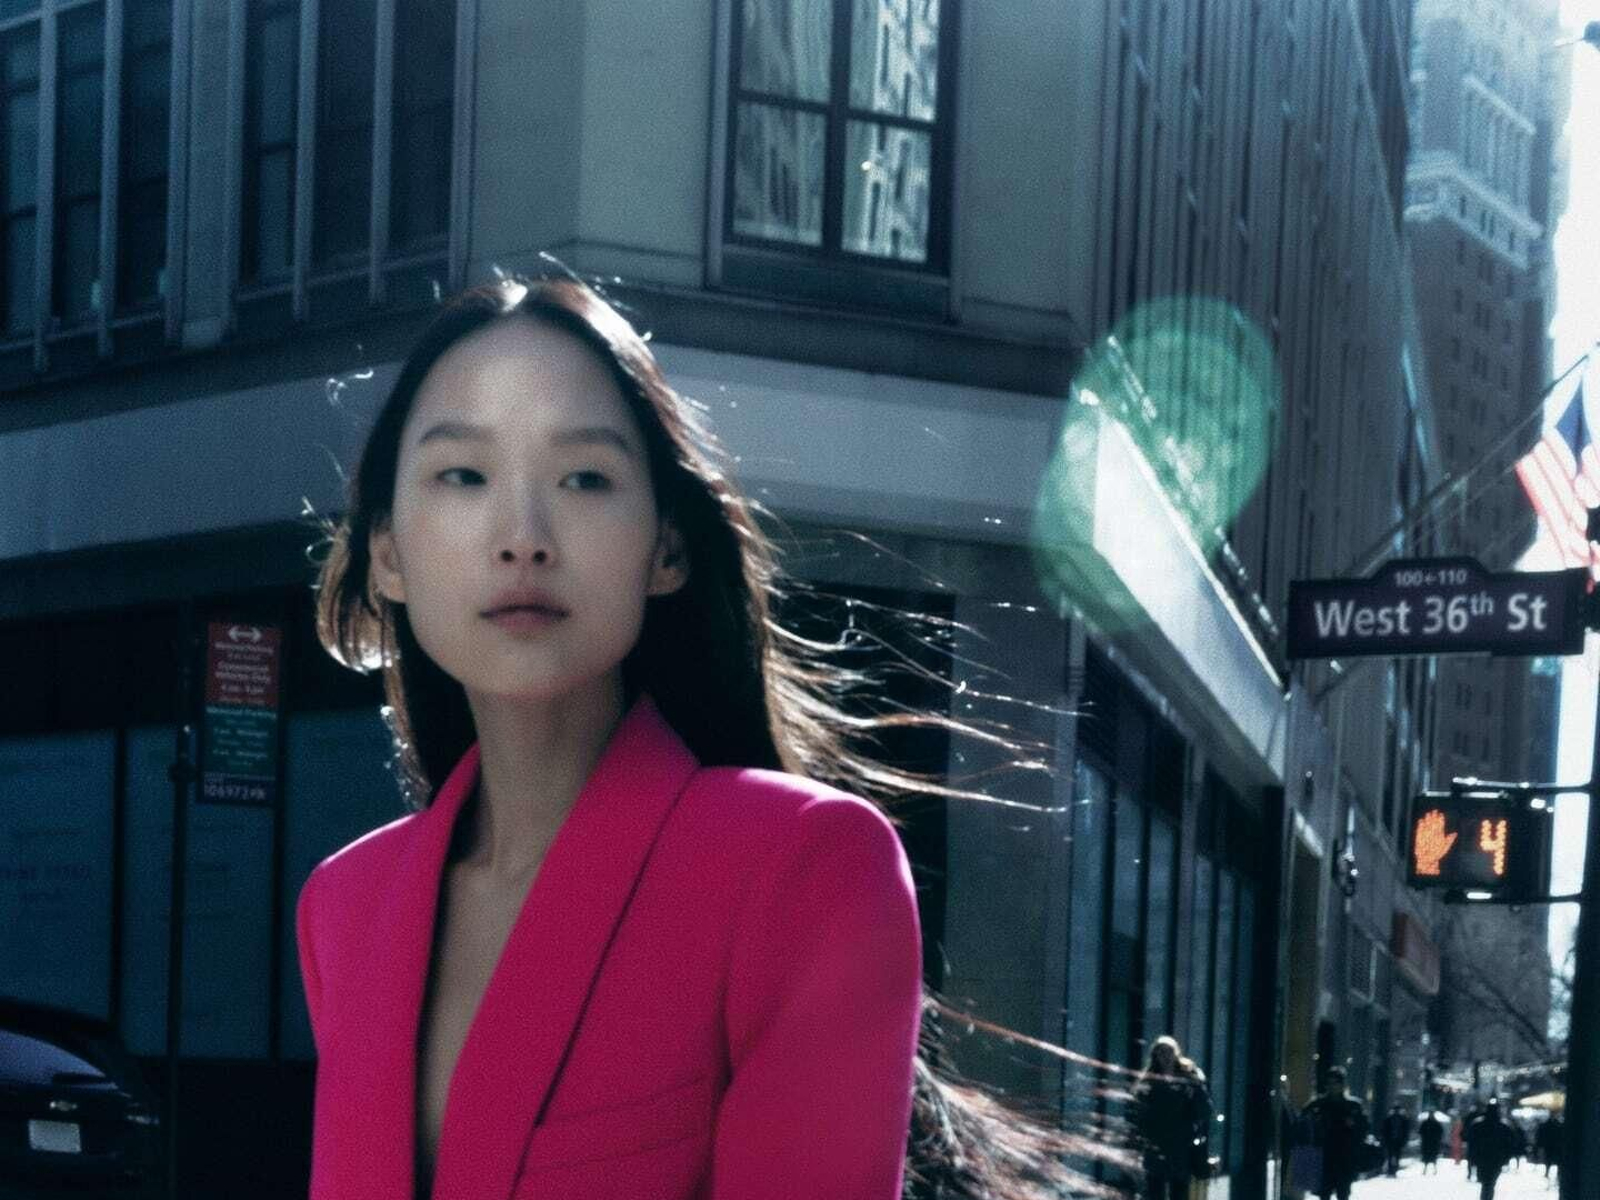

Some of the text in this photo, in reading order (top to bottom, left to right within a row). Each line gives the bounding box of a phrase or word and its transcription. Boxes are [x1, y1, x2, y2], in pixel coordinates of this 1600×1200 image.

[1395, 568, 1467, 586] 100 110
[1313, 590, 1546, 638] West 36th St
[1480, 819, 1507, 875] 4
